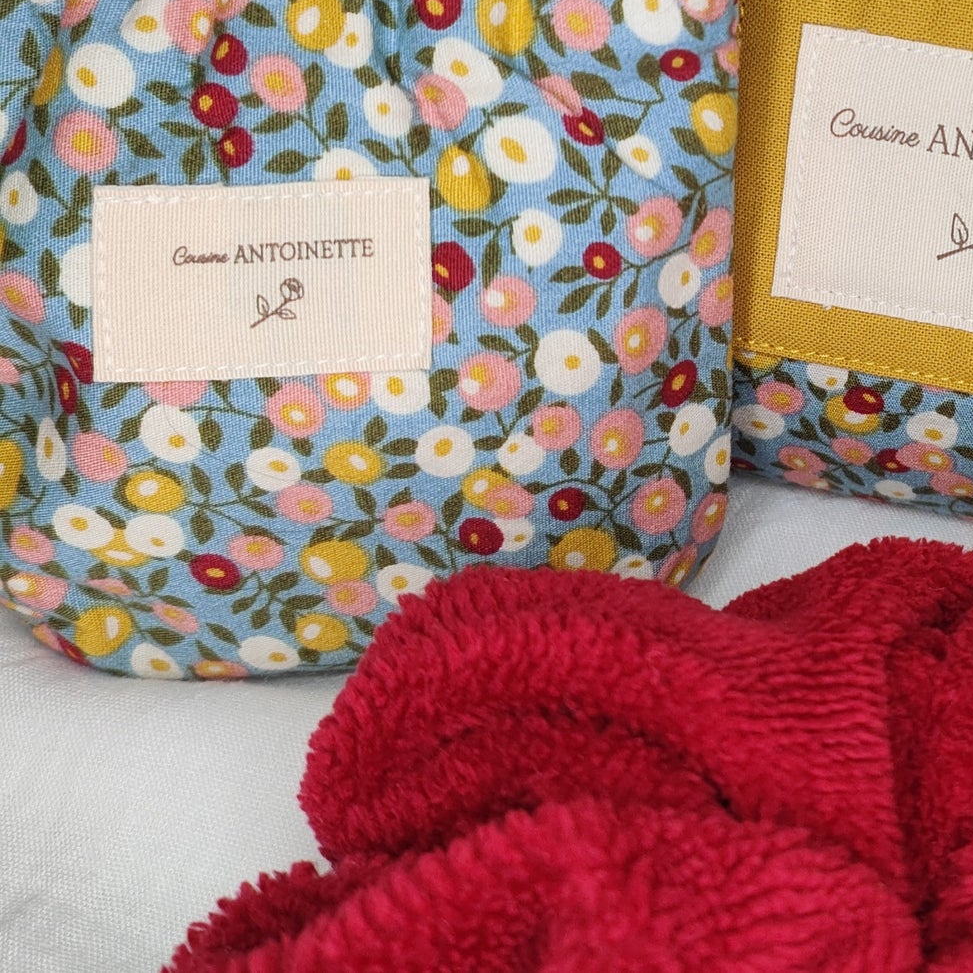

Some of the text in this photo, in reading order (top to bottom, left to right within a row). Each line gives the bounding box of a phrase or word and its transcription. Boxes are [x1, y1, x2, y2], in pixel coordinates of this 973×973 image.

[830, 108, 920, 147] Cousine
[172, 238, 374, 265] Cousine ANTOINETTE
